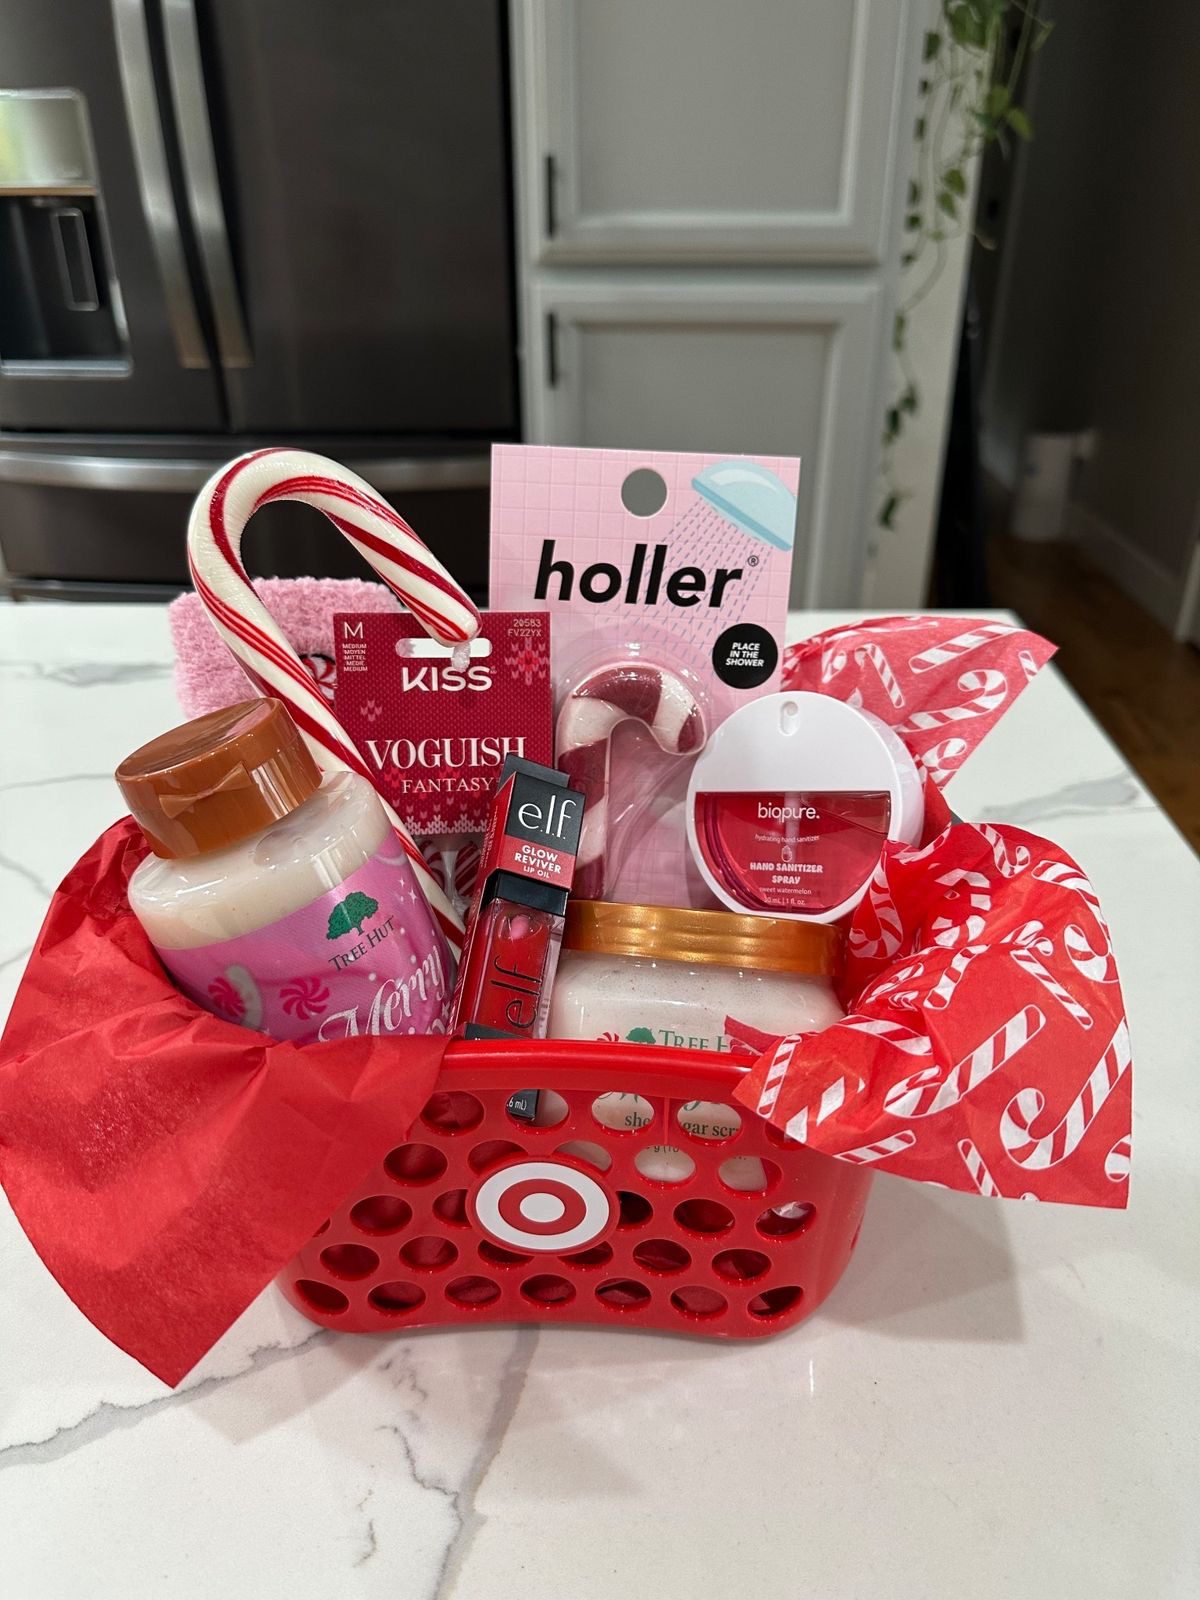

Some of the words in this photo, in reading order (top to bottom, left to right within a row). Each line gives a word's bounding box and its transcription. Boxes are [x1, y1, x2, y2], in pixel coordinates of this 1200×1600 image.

[343, 621, 364, 639] M
[513, 618, 541, 628] 20583
[507, 628, 542, 637] FV22YX
[732, 642, 760, 651] PLACE
[729, 650, 740, 658] IN
[742, 651, 760, 659] THE
[725, 658, 765, 667] SHOWER
[402, 665, 493, 692] KISS
[365, 736, 527, 771] VOGUISH
[402, 777, 494, 794] FANTASY
[522, 844, 558, 863] GLOW
[514, 852, 562, 874] REVIVER
[749, 862, 775, 872] HAND
[775, 862, 824, 874] SANITIZER
[523, 865, 535, 874] LIP
[537, 869, 550, 879] OIL
[771, 875, 801, 885] SPRAY
[776, 887, 812, 895] watermelon
[328, 942, 368, 971] TREE
[366, 914, 395, 949] HUT
[318, 944, 446, 1042] Merry
[624, 1111, 651, 1128] she
